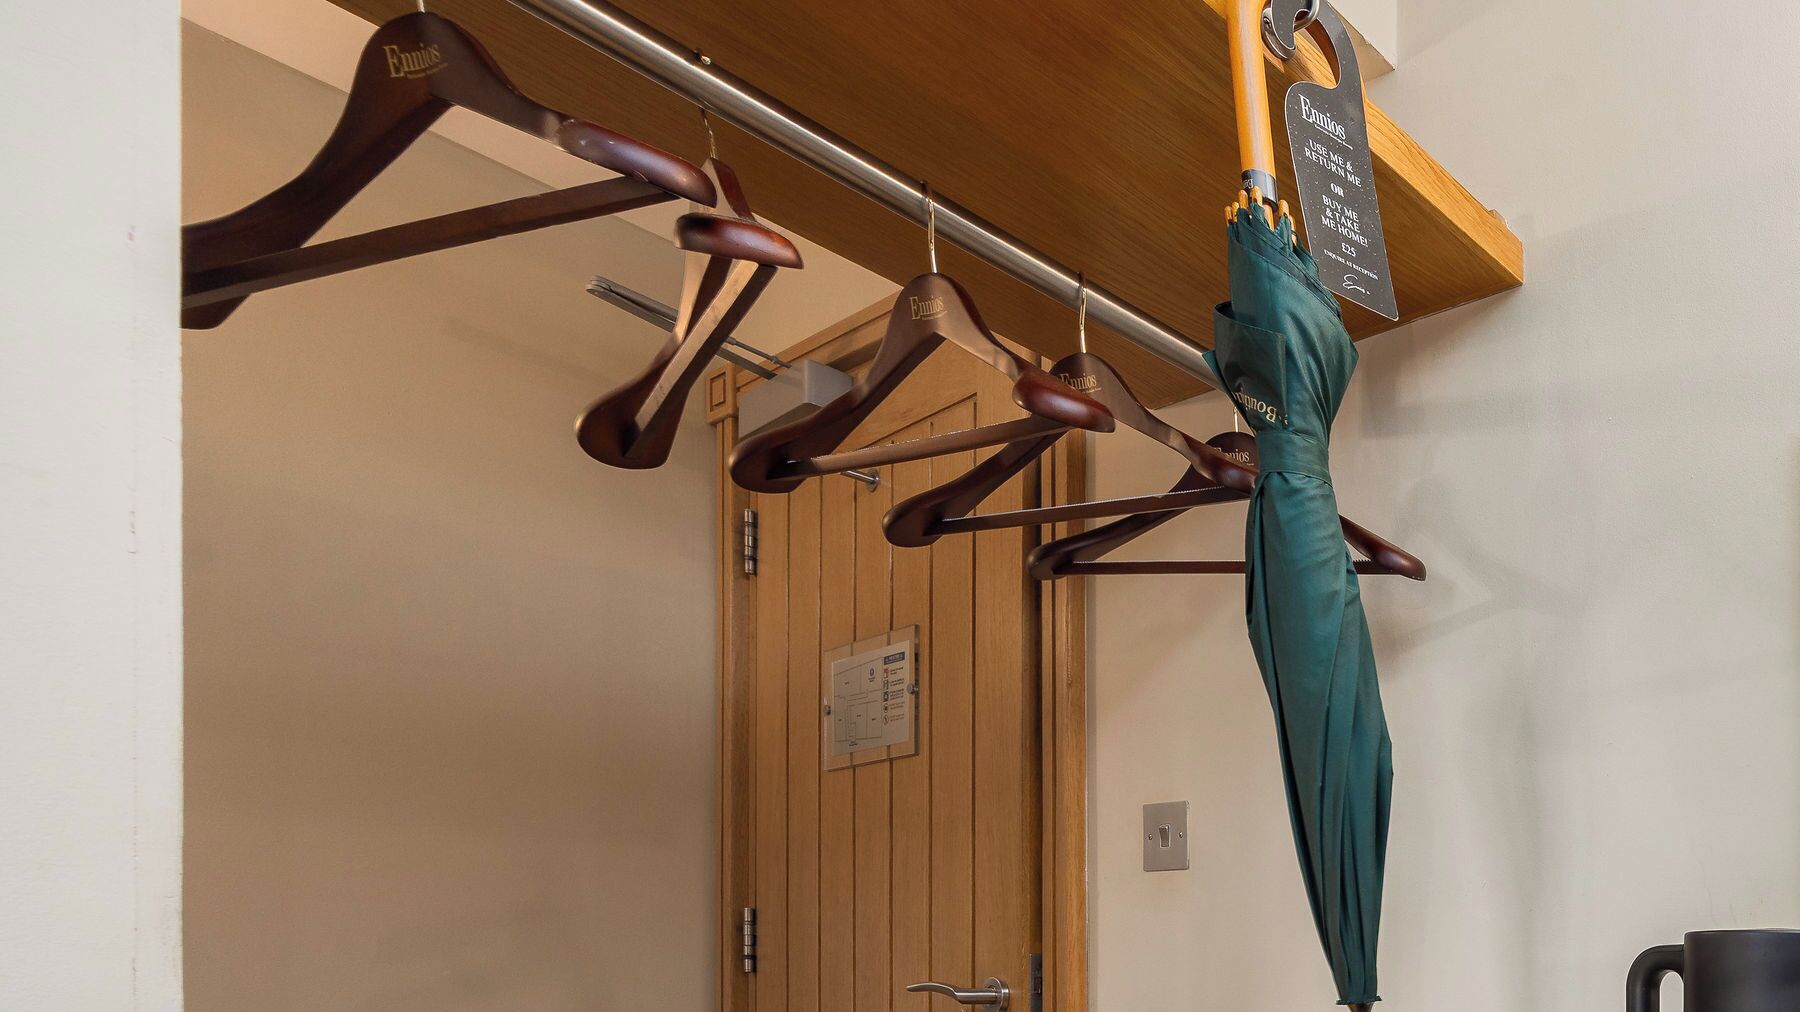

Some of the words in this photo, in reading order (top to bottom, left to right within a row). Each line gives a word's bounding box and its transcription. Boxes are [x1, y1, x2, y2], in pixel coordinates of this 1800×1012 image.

[383, 43, 441, 78] Ennios
[1298, 94, 1346, 140] Ennios
[1305, 147, 1345, 178] RETURN
[1346, 172, 1362, 187] ME
[1309, 139, 1328, 158] USE
[1330, 151, 1345, 168] ME
[1331, 183, 1344, 198] OR
[1322, 195, 1342, 212] BUY
[1344, 206, 1359, 222] ME
[1334, 211, 1360, 233] TAKE
[1321, 215, 1337, 231] ME
[1338, 224, 1368, 248] HOME!
[1341, 242, 1357, 257] £25
[909, 295, 944, 320] Ennios
